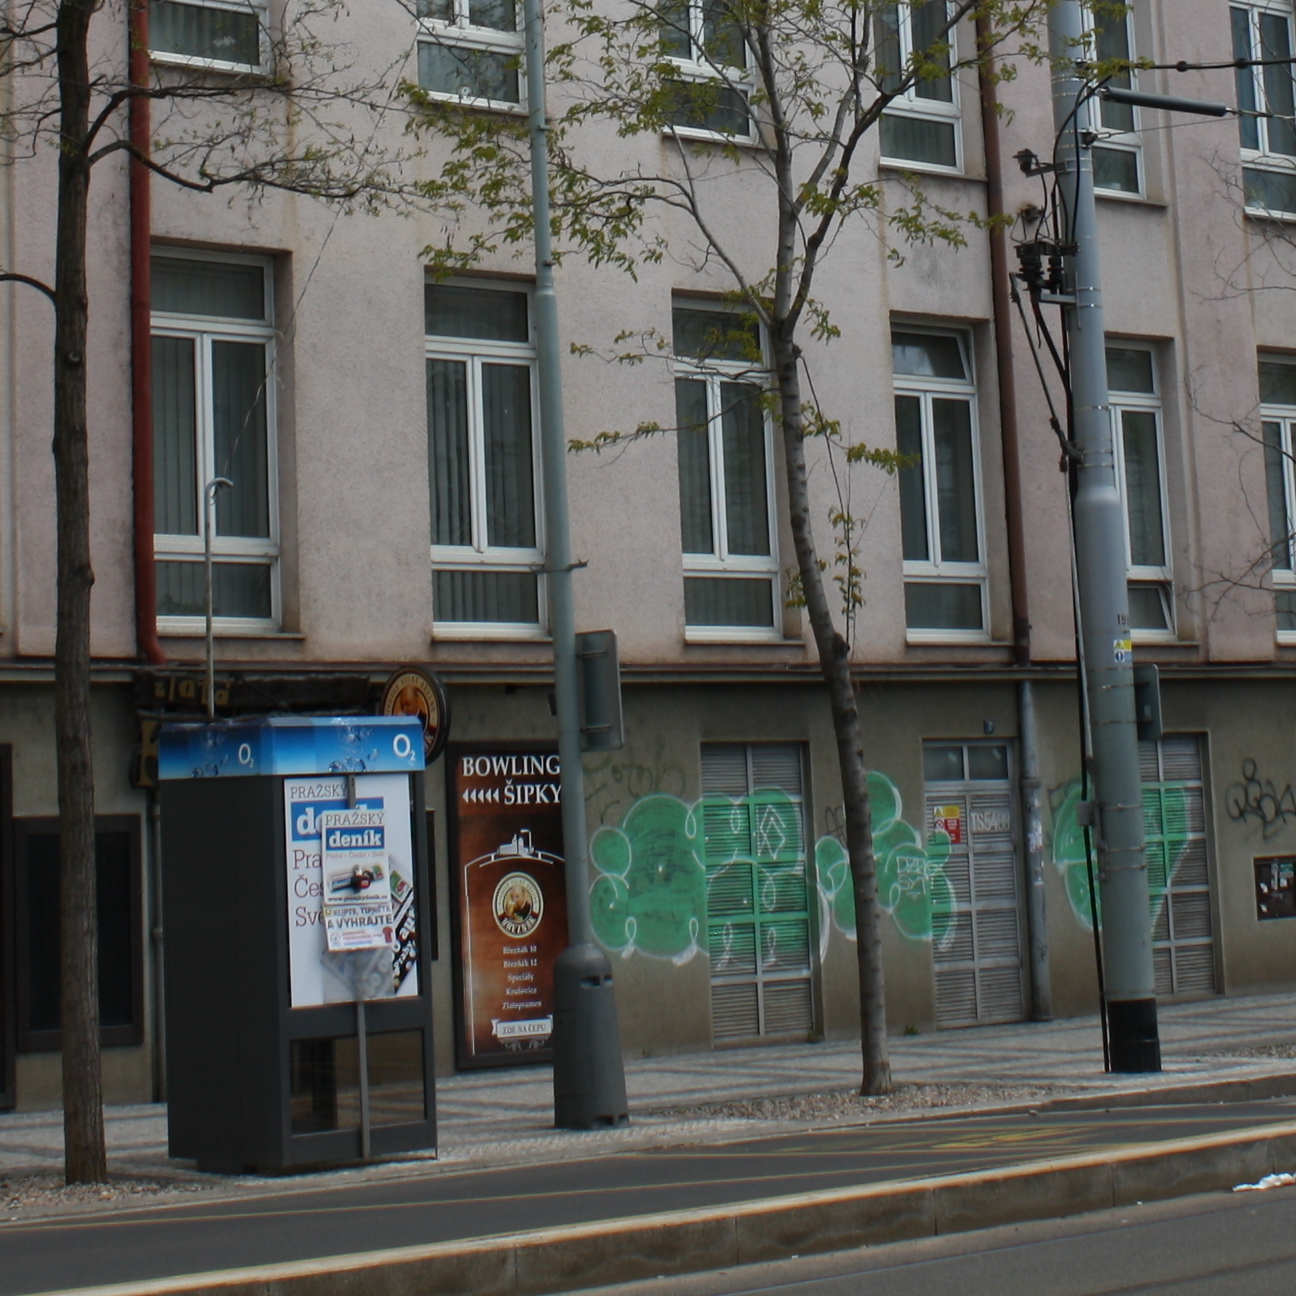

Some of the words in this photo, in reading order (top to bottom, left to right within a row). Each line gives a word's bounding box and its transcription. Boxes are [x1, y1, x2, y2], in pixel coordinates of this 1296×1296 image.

[393, 733, 416, 762] O2
[462, 755, 560, 777] BOWLING
[504, 778, 562, 805] ŠIPKY
[328, 829, 383, 848] deník
[336, 915, 393, 929] VYHRAJTE
